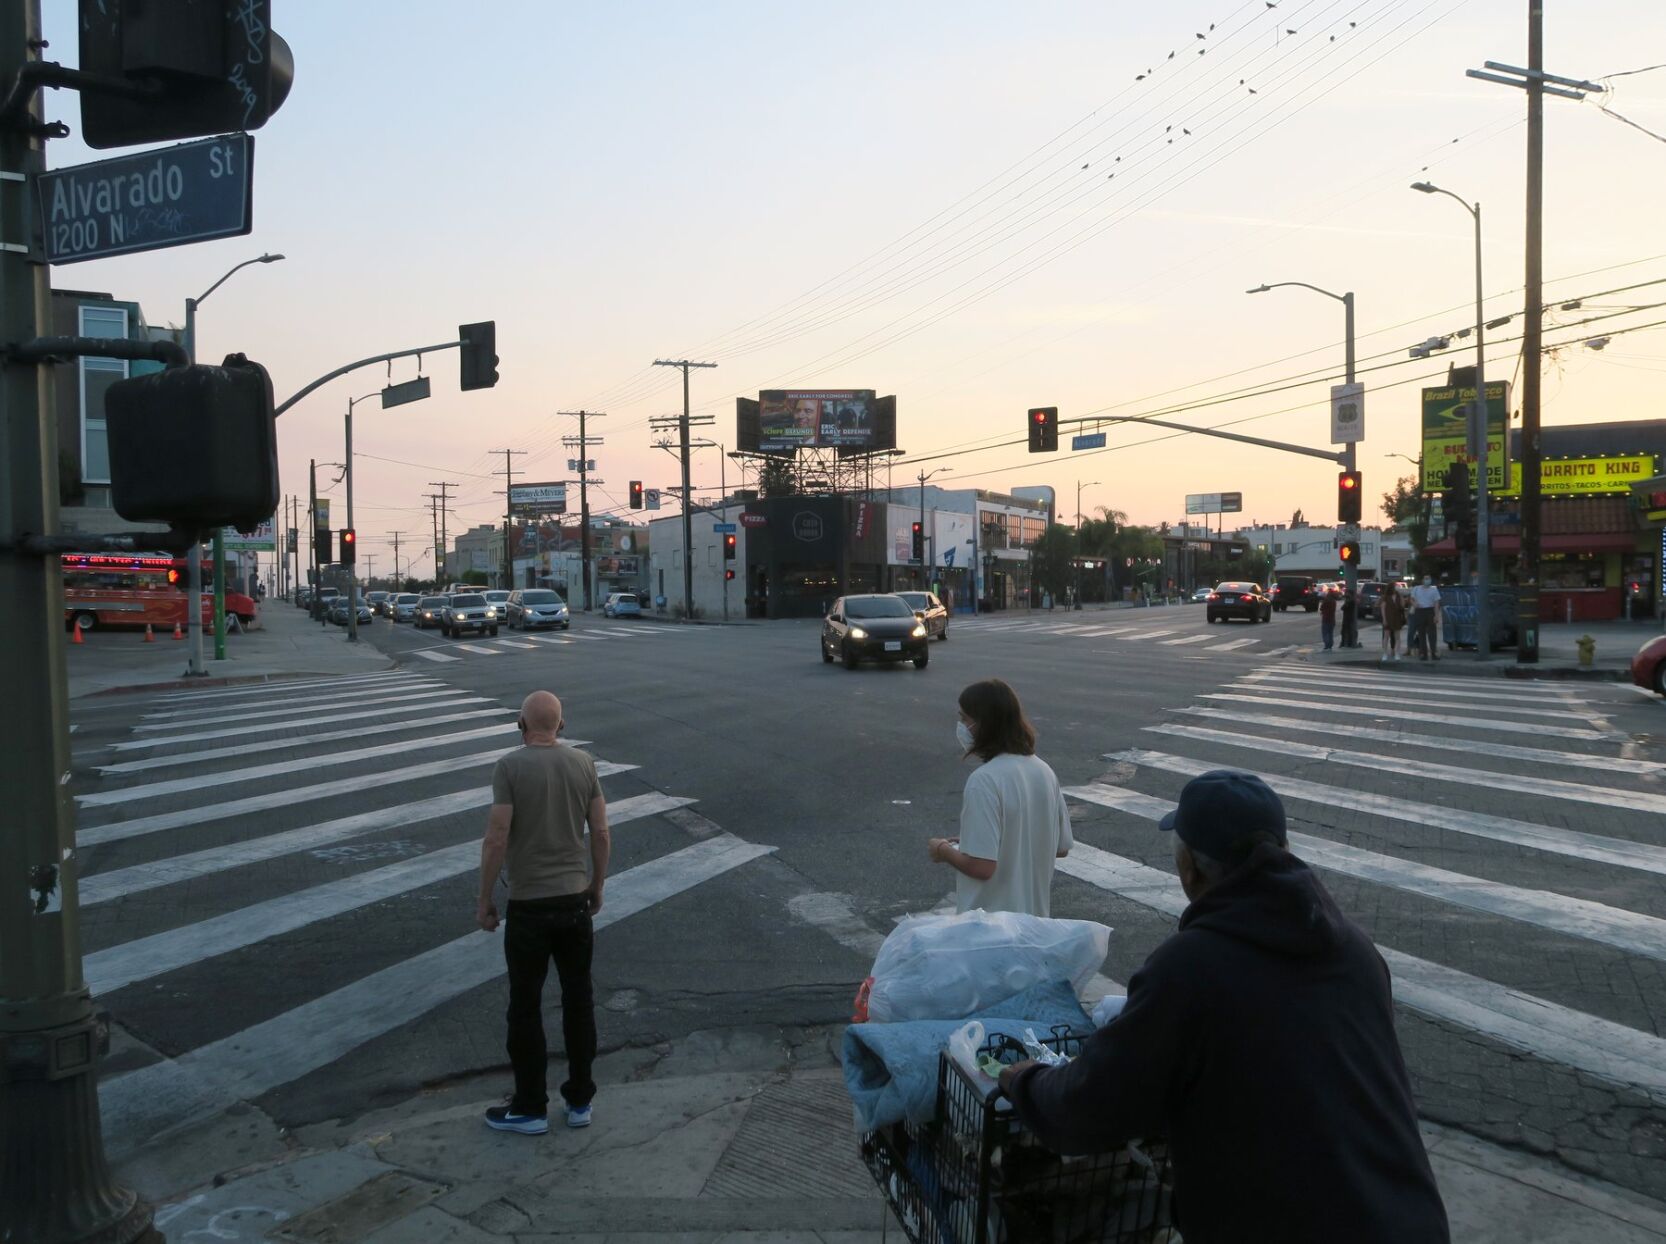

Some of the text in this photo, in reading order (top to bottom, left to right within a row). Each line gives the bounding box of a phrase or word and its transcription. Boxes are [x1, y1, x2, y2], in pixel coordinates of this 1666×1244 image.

[51, 146, 234, 222] Alvarado St
[52, 220, 98, 254] 1200
[110, 214, 124, 243] N
[1541, 461, 1640, 477] URRITO KING
[1574, 481, 1602, 489] TACOS
[856, 503, 866, 537] PIZZA
